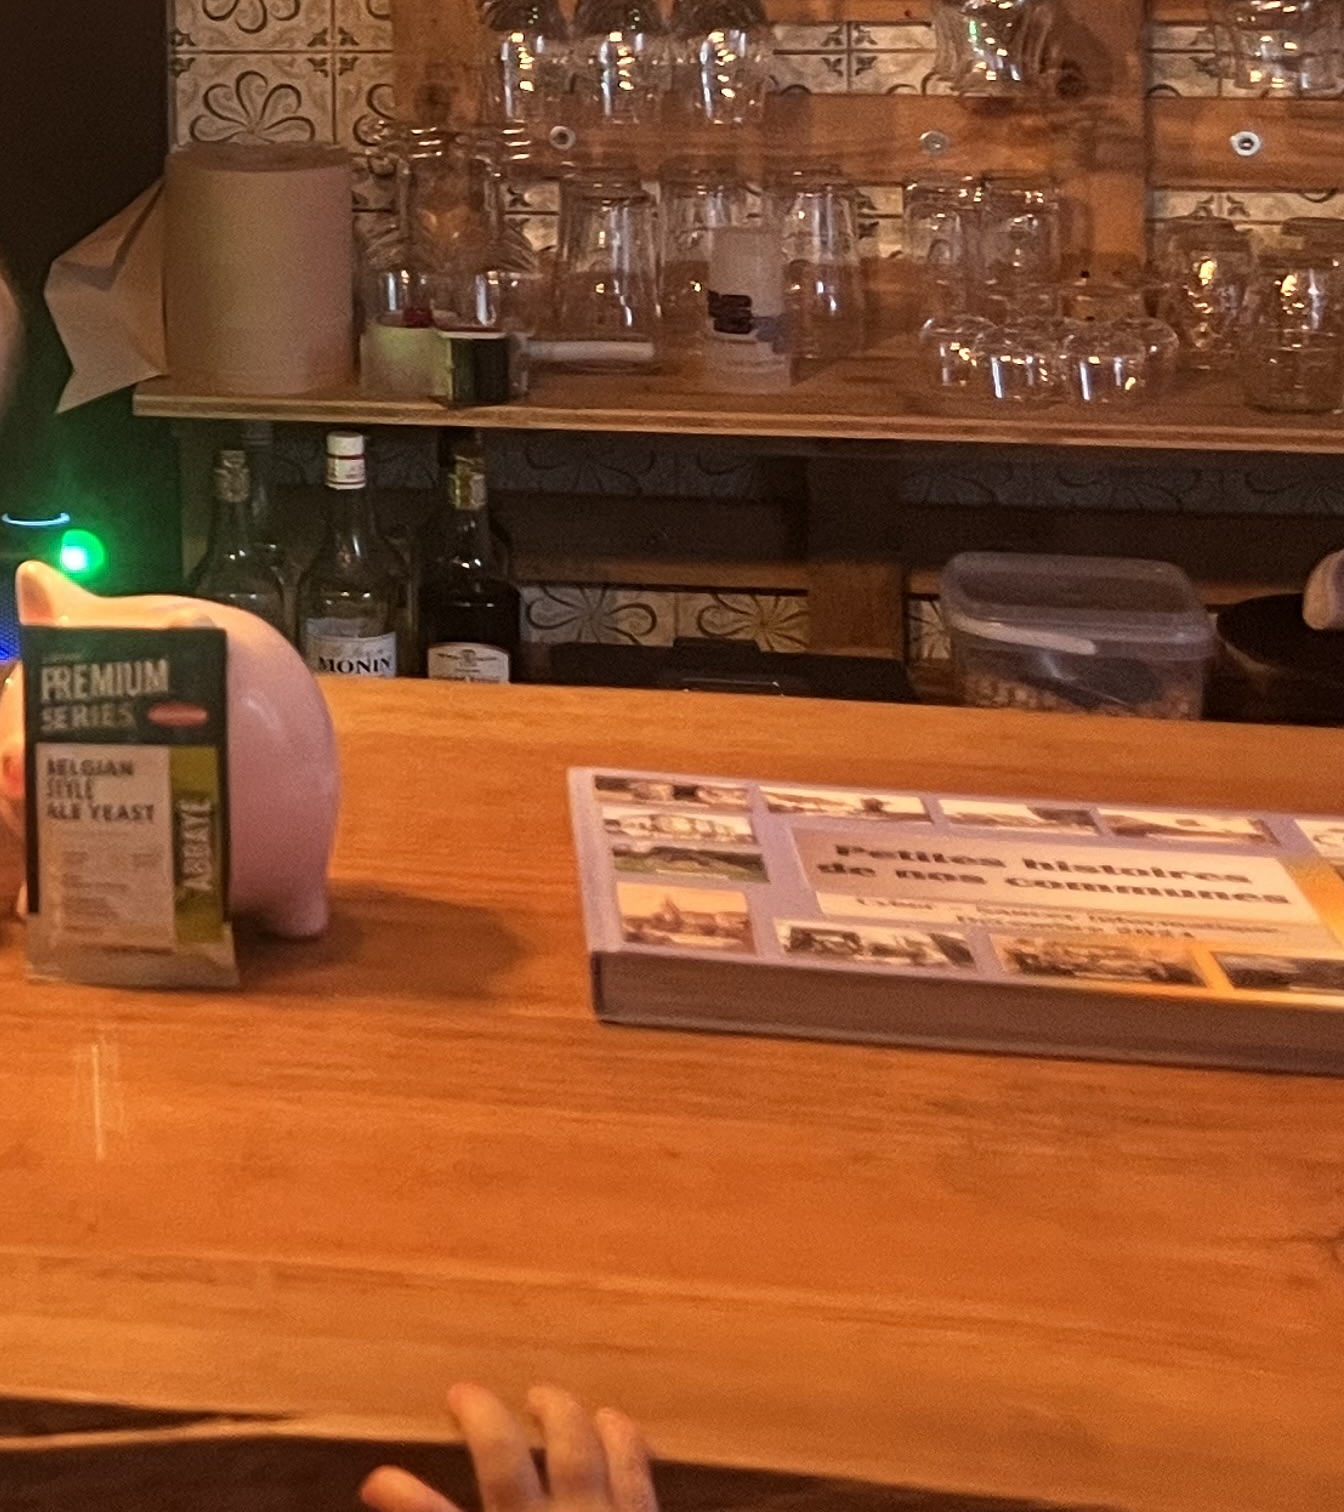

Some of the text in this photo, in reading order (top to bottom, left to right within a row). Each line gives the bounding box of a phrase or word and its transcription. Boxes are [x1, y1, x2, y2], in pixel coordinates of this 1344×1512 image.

[41, 659, 169, 702] PREMIUM
[318, 656, 392, 674] MONIN
[90, 803, 155, 821] YEAST
[818, 861, 1293, 905] de nos communes
[835, 844, 1252, 884] Petites histoires
